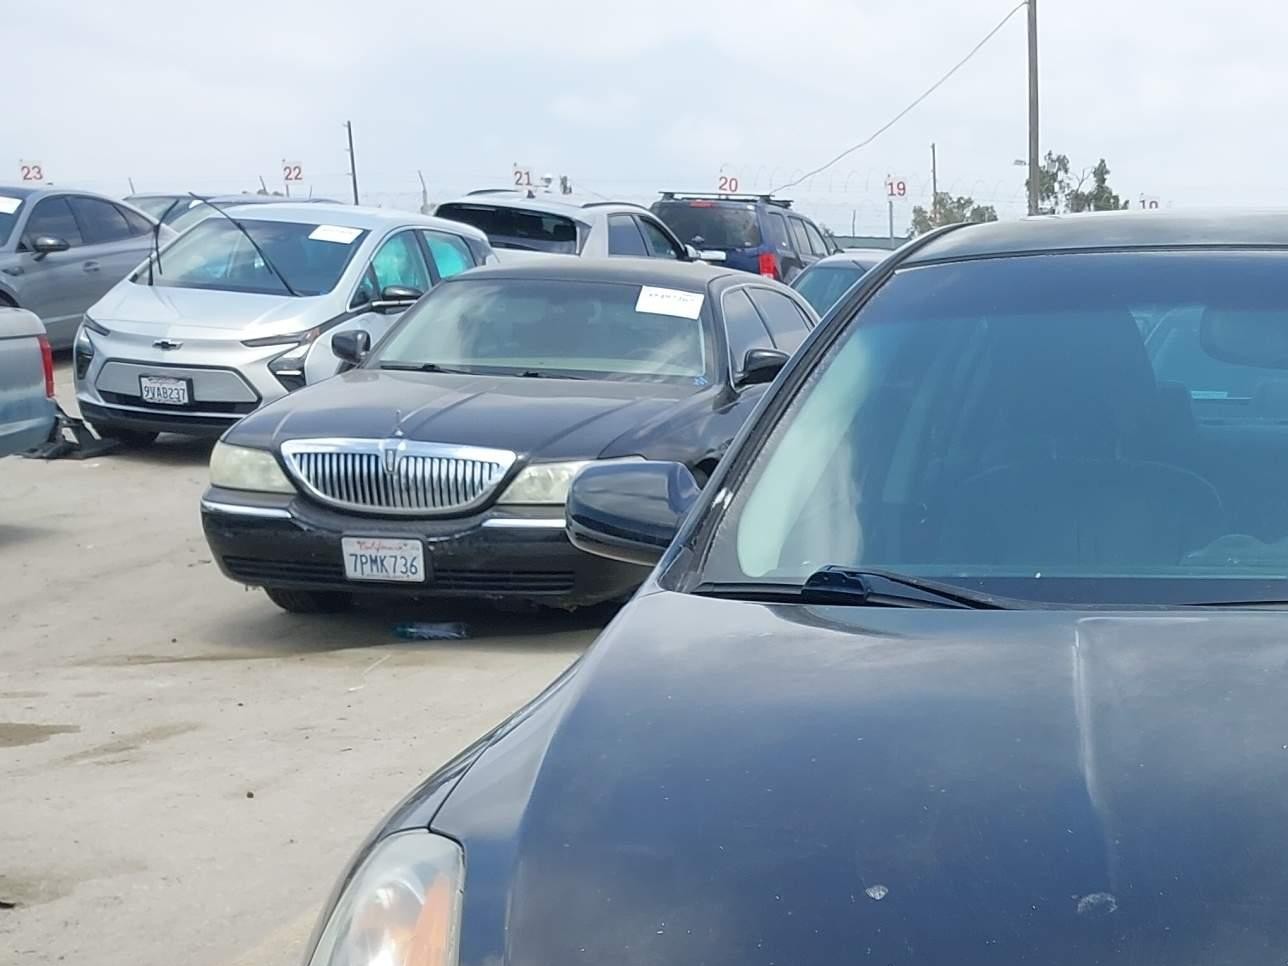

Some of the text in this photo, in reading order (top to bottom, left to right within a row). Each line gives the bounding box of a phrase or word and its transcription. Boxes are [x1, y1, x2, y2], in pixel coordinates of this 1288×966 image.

[21, 165, 43, 181] 23
[283, 166, 303, 181] 22
[514, 170, 533, 186] 21
[719, 176, 738, 192] 20
[887, 181, 906, 197] 19
[349, 553, 418, 576] 7PMK736
